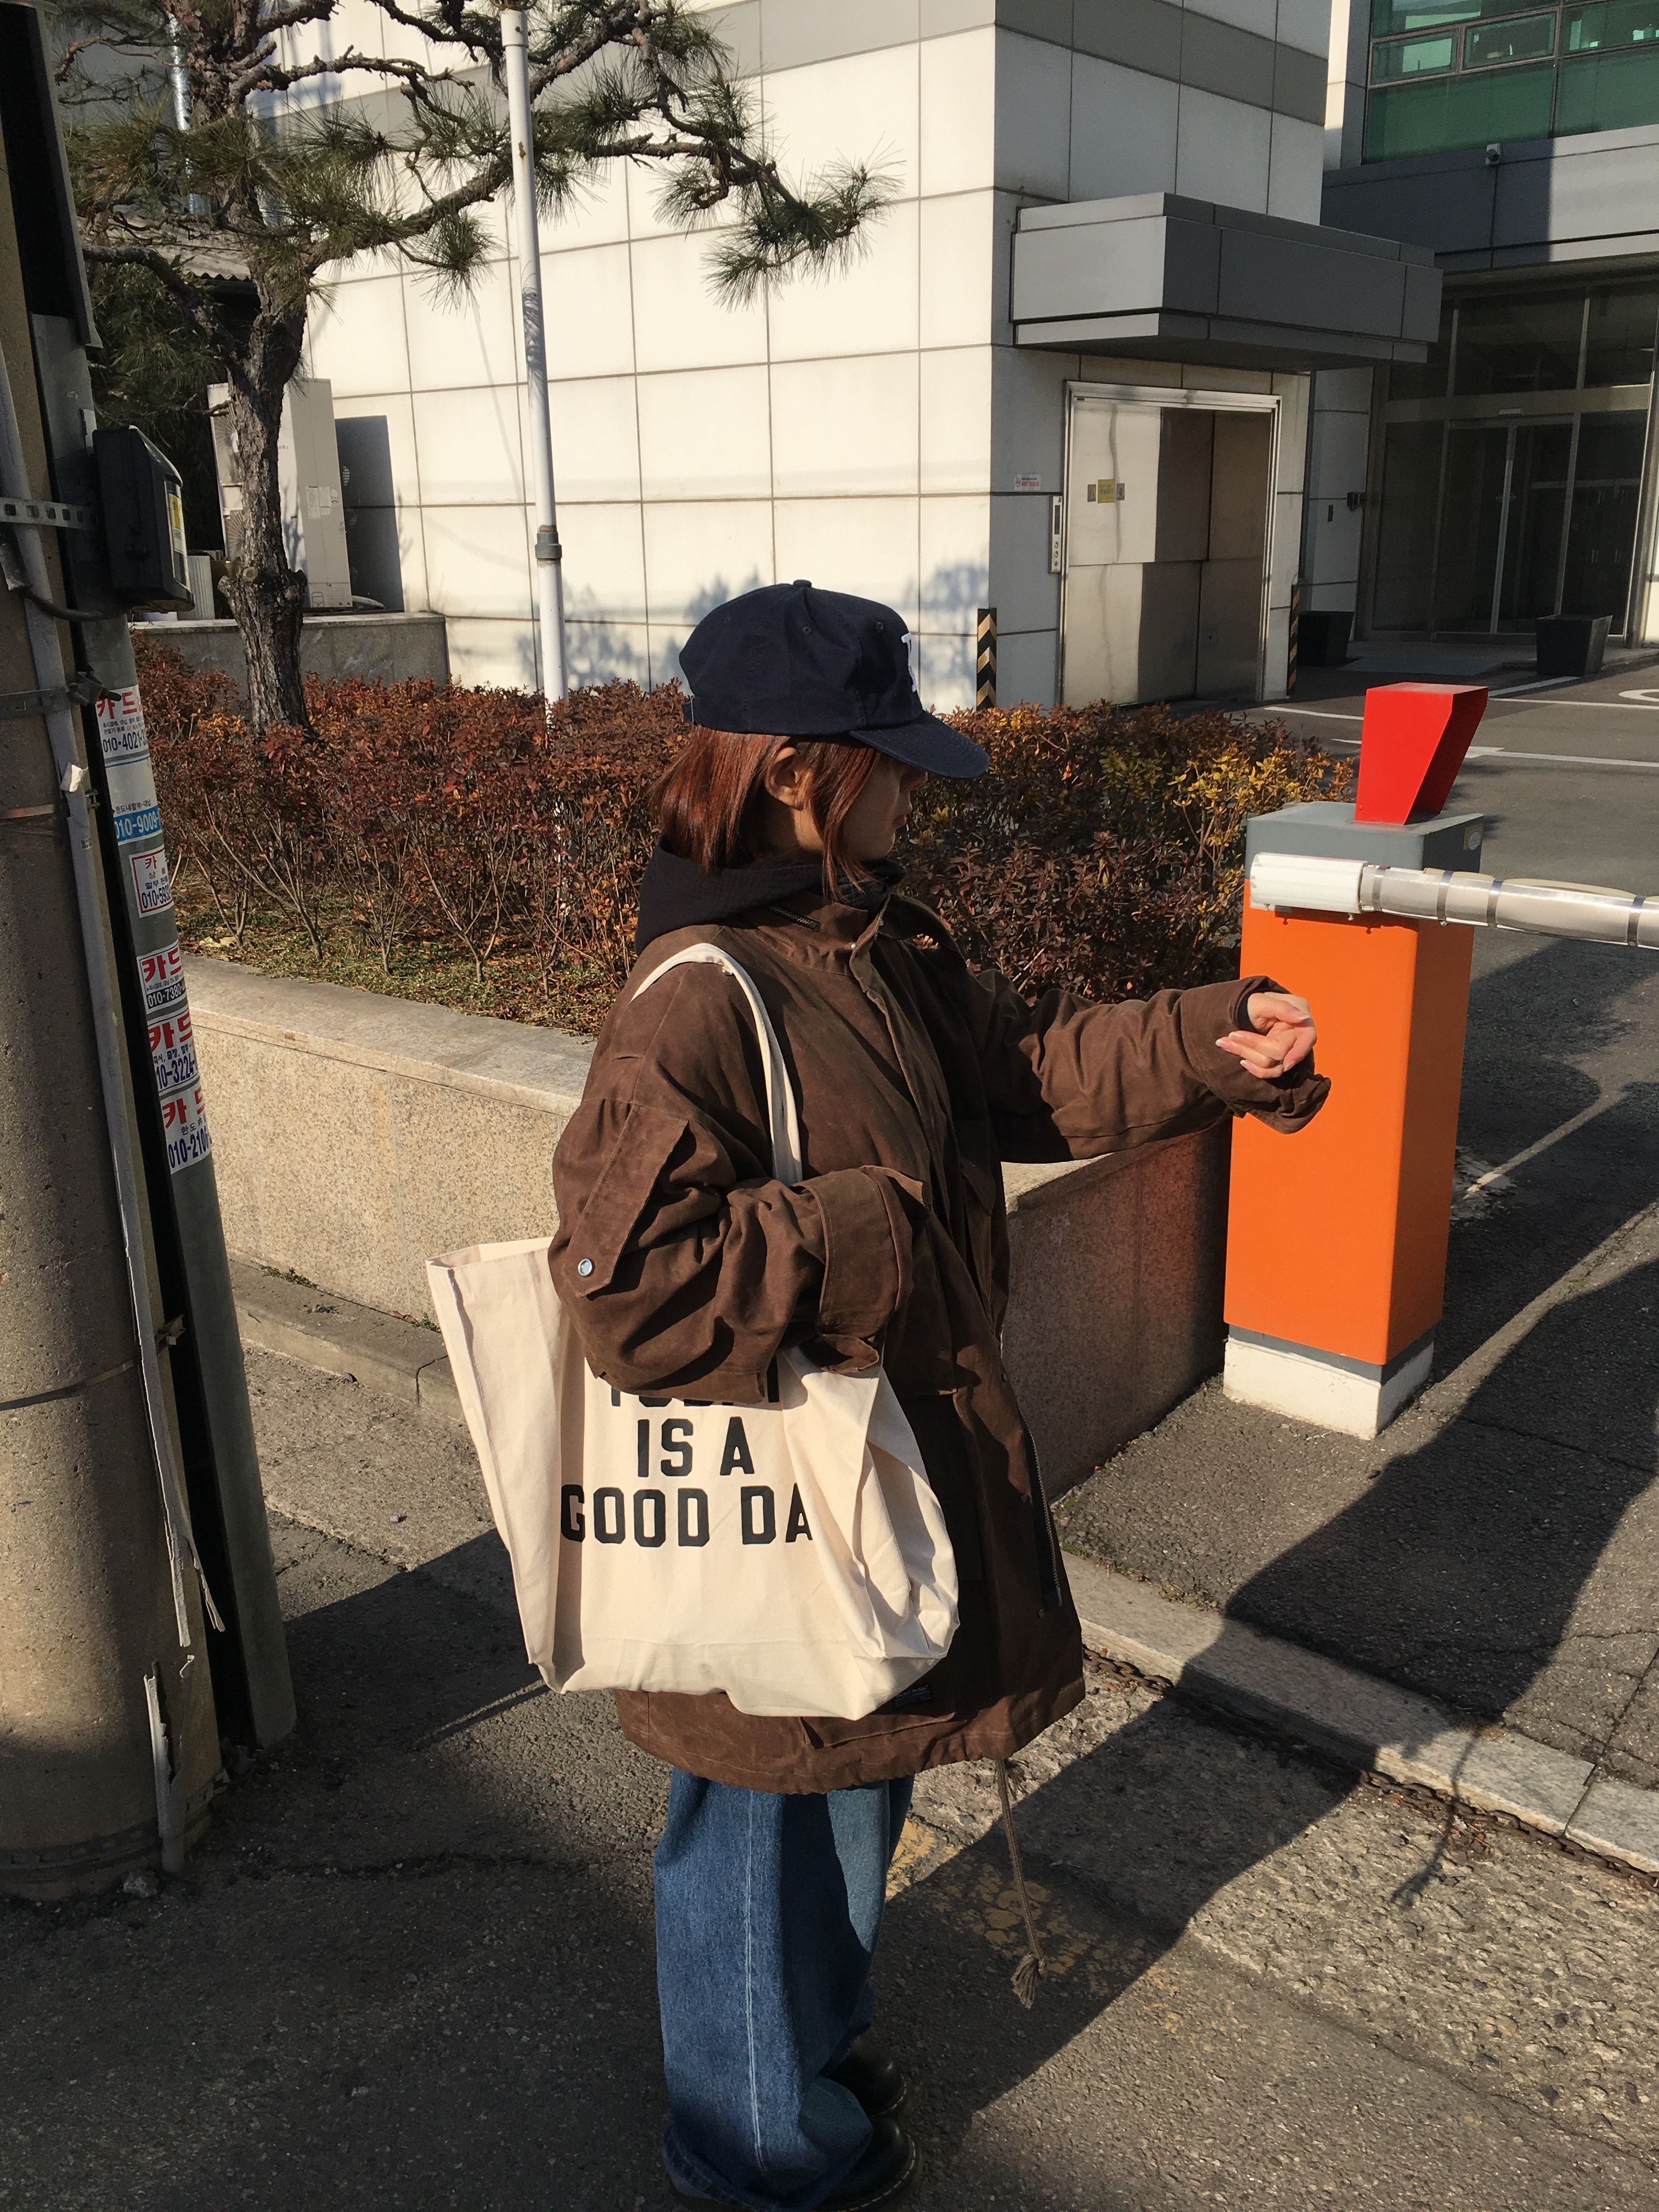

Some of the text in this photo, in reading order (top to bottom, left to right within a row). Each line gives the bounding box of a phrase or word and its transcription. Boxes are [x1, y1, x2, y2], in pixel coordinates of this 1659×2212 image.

[142, 947, 183, 983] 카드
[148, 1011, 193, 1052] 카드
[637, 1416, 755, 1477] IS A
[561, 1484, 710, 1548] GOOD
